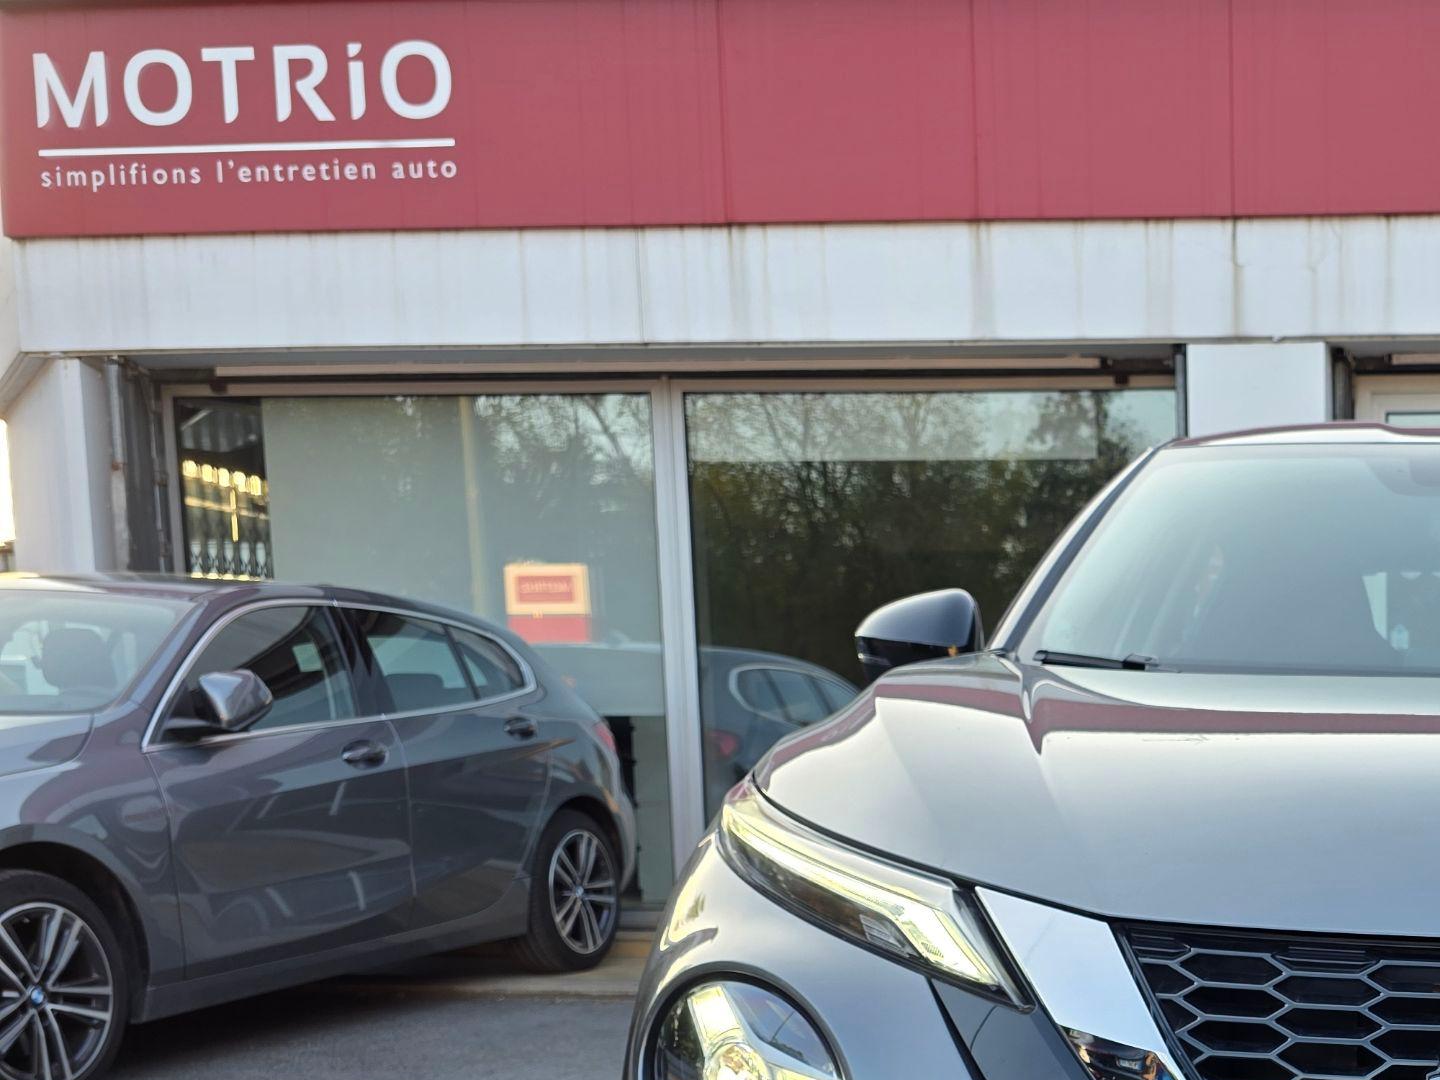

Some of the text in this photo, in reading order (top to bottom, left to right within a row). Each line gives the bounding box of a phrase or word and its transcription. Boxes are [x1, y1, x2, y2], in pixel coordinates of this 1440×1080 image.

[40, 159, 457, 193] simplifions l'entretien auto
